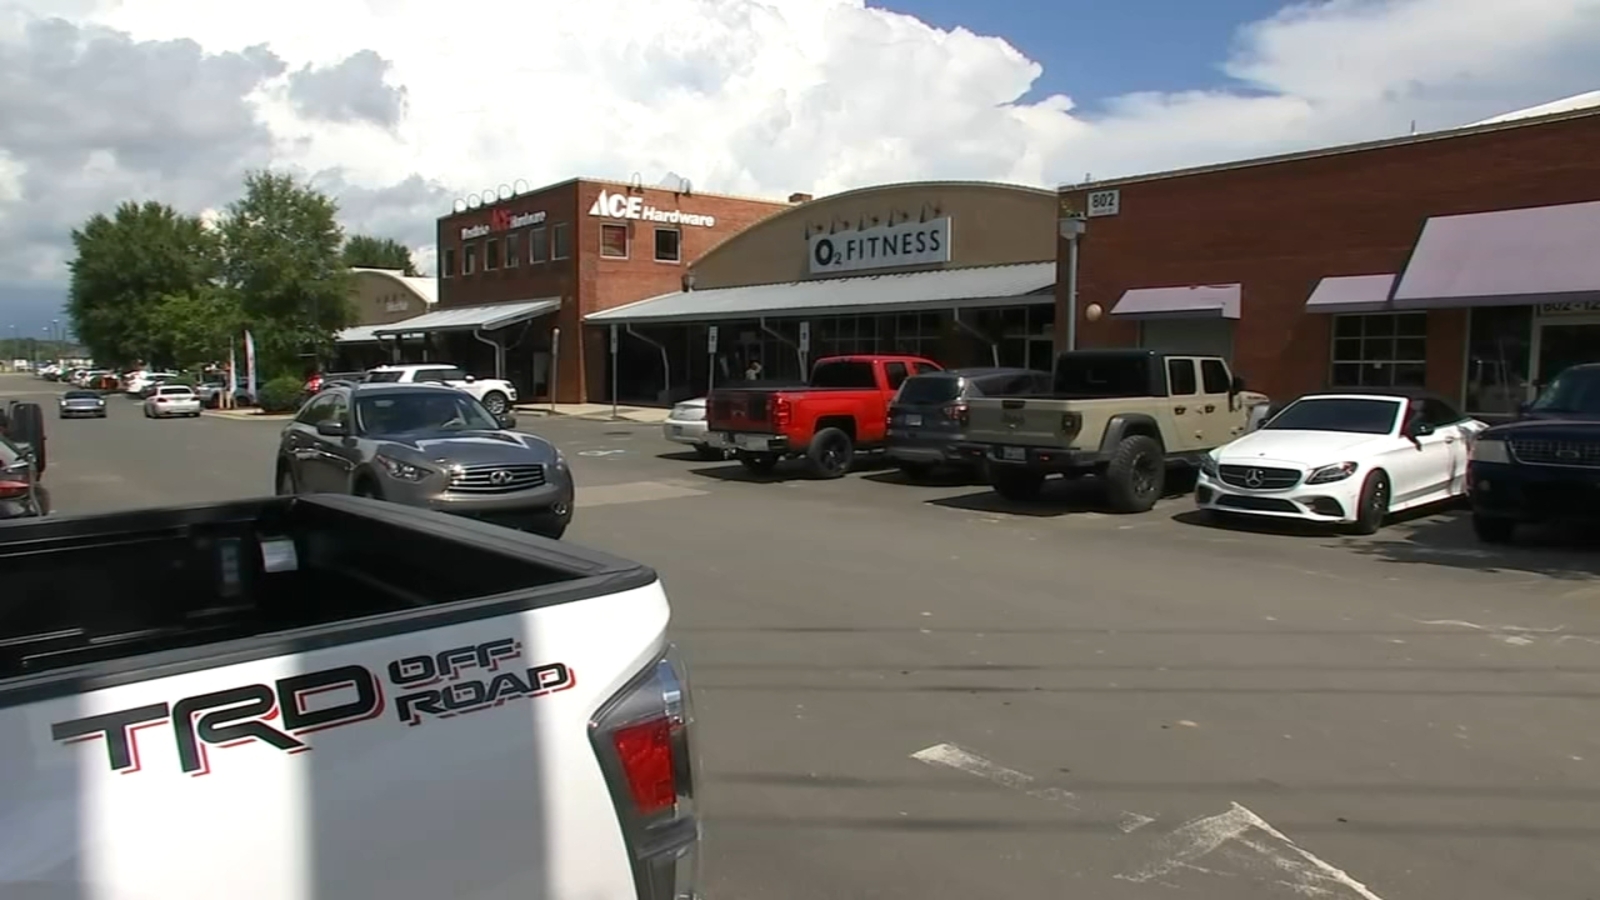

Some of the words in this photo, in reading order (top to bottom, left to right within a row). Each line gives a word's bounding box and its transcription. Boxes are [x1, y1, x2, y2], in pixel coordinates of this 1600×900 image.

[588, 189, 643, 220] ACE
[642, 205, 715, 227] Hardware
[1092, 192, 1115, 208] 802
[846, 229, 941, 261] FITNESS
[388, 638, 521, 689] OFF
[395, 662, 576, 726] ROAD
[52, 665, 384, 777] TRD
